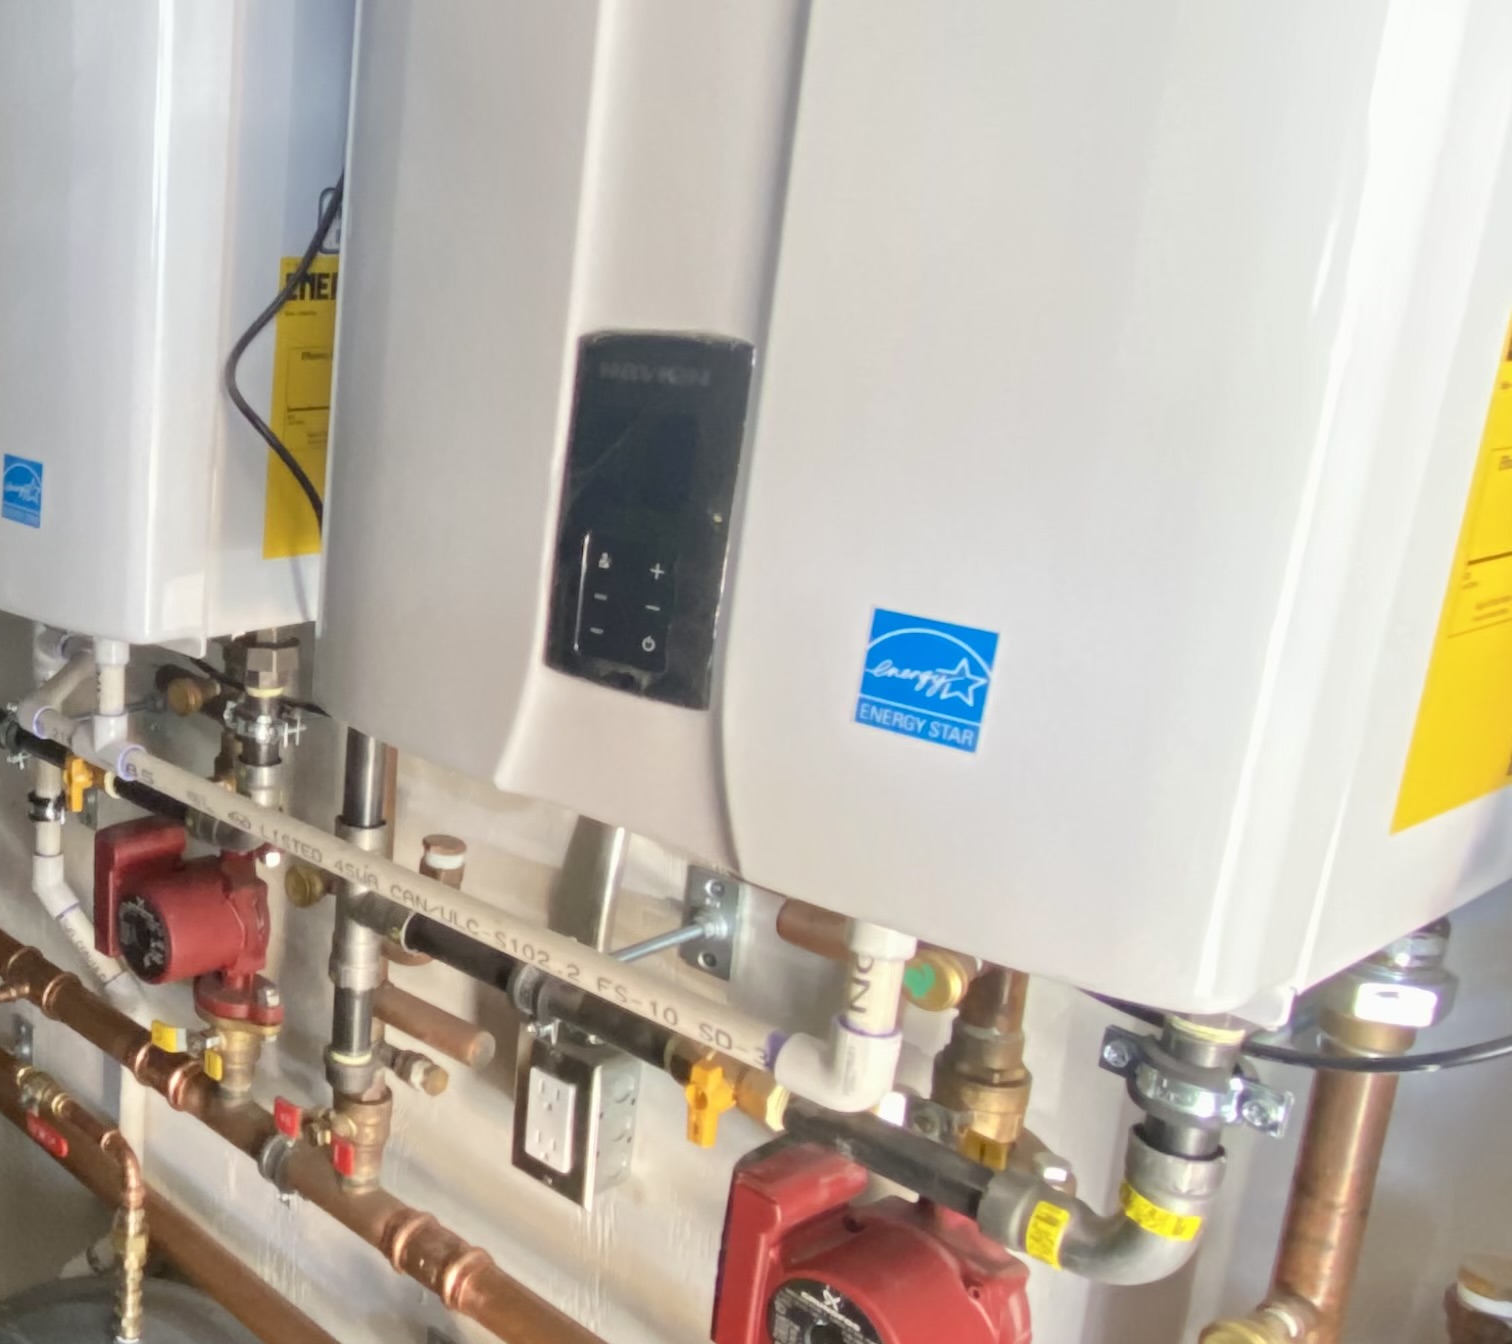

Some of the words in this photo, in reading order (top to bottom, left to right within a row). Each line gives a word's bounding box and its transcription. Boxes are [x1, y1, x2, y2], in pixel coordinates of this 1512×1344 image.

[865, 658, 952, 698] energy
[859, 702, 928, 734] ENERGY
[928, 720, 975, 747] STAR
[260, 824, 324, 864] LISTED
[390, 882, 581, 983] CAN/ULC-S102.2
[596, 976, 678, 1027] FS-10
